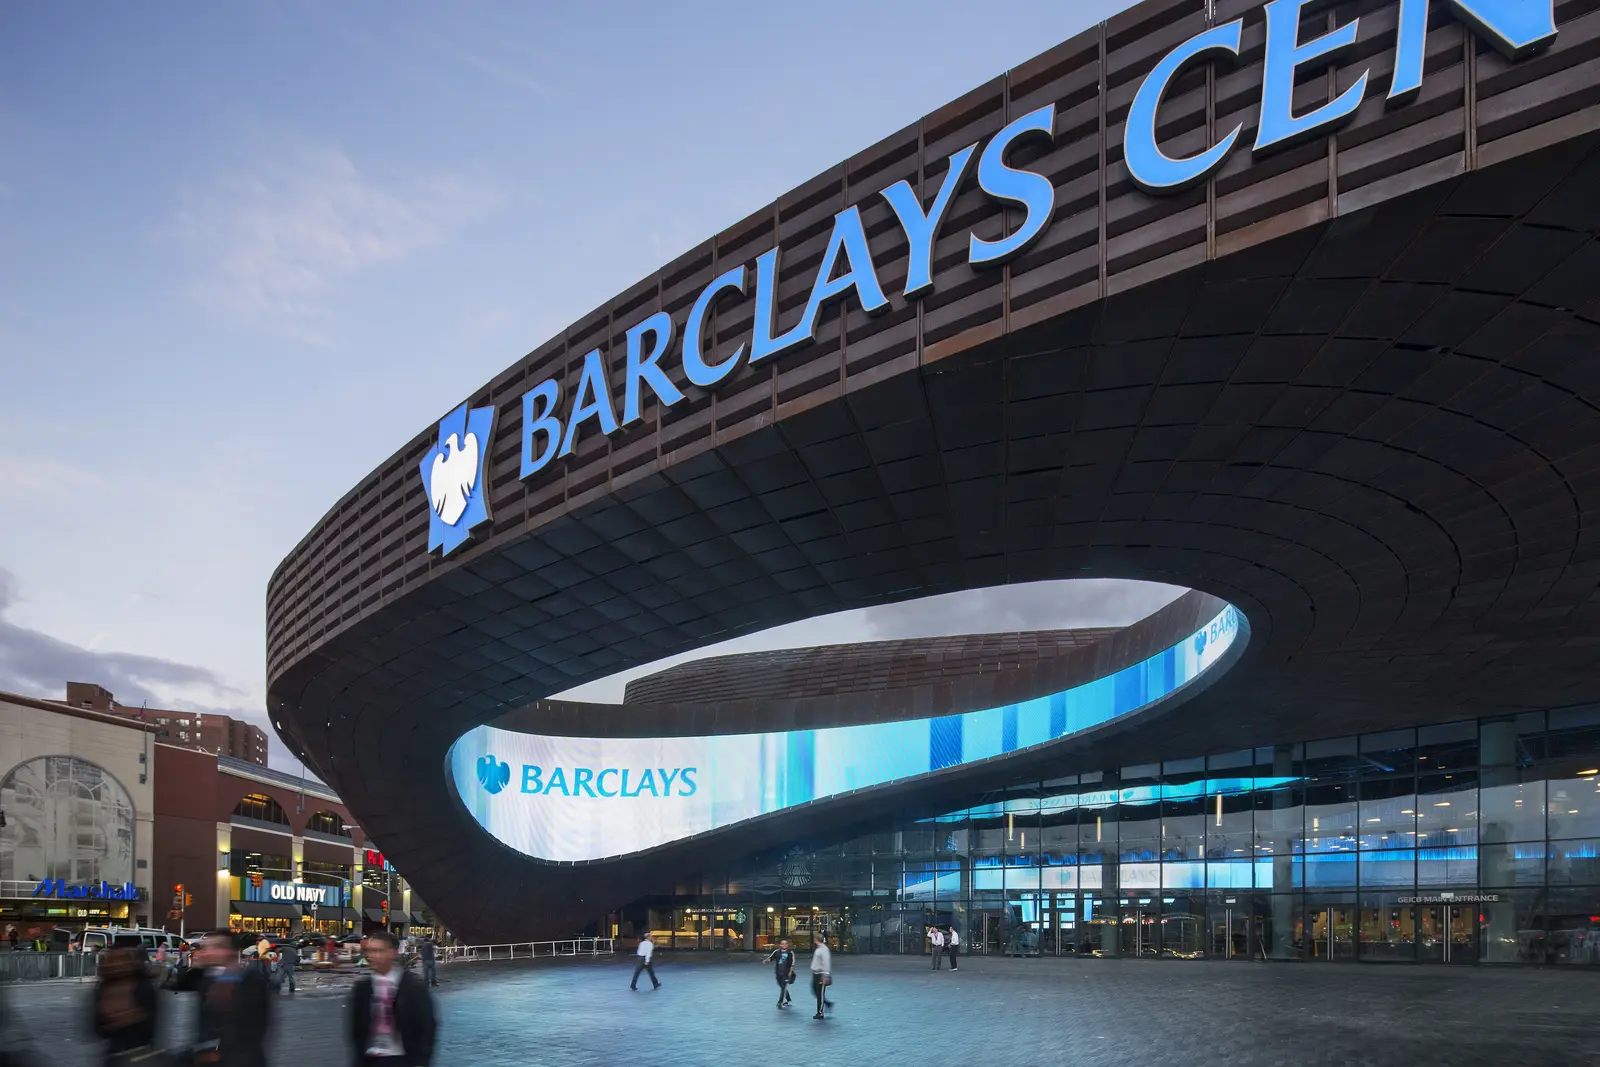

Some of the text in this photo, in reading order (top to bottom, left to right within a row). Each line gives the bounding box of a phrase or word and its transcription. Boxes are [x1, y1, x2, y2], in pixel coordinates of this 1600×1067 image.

[518, 103, 1057, 482] BARCLAYS
[520, 764, 697, 798] BARCLAYS
[271, 884, 327, 903] OLD NAVY
[1397, 896, 1422, 904] GEICO
[1424, 895, 1447, 903] MAIN
